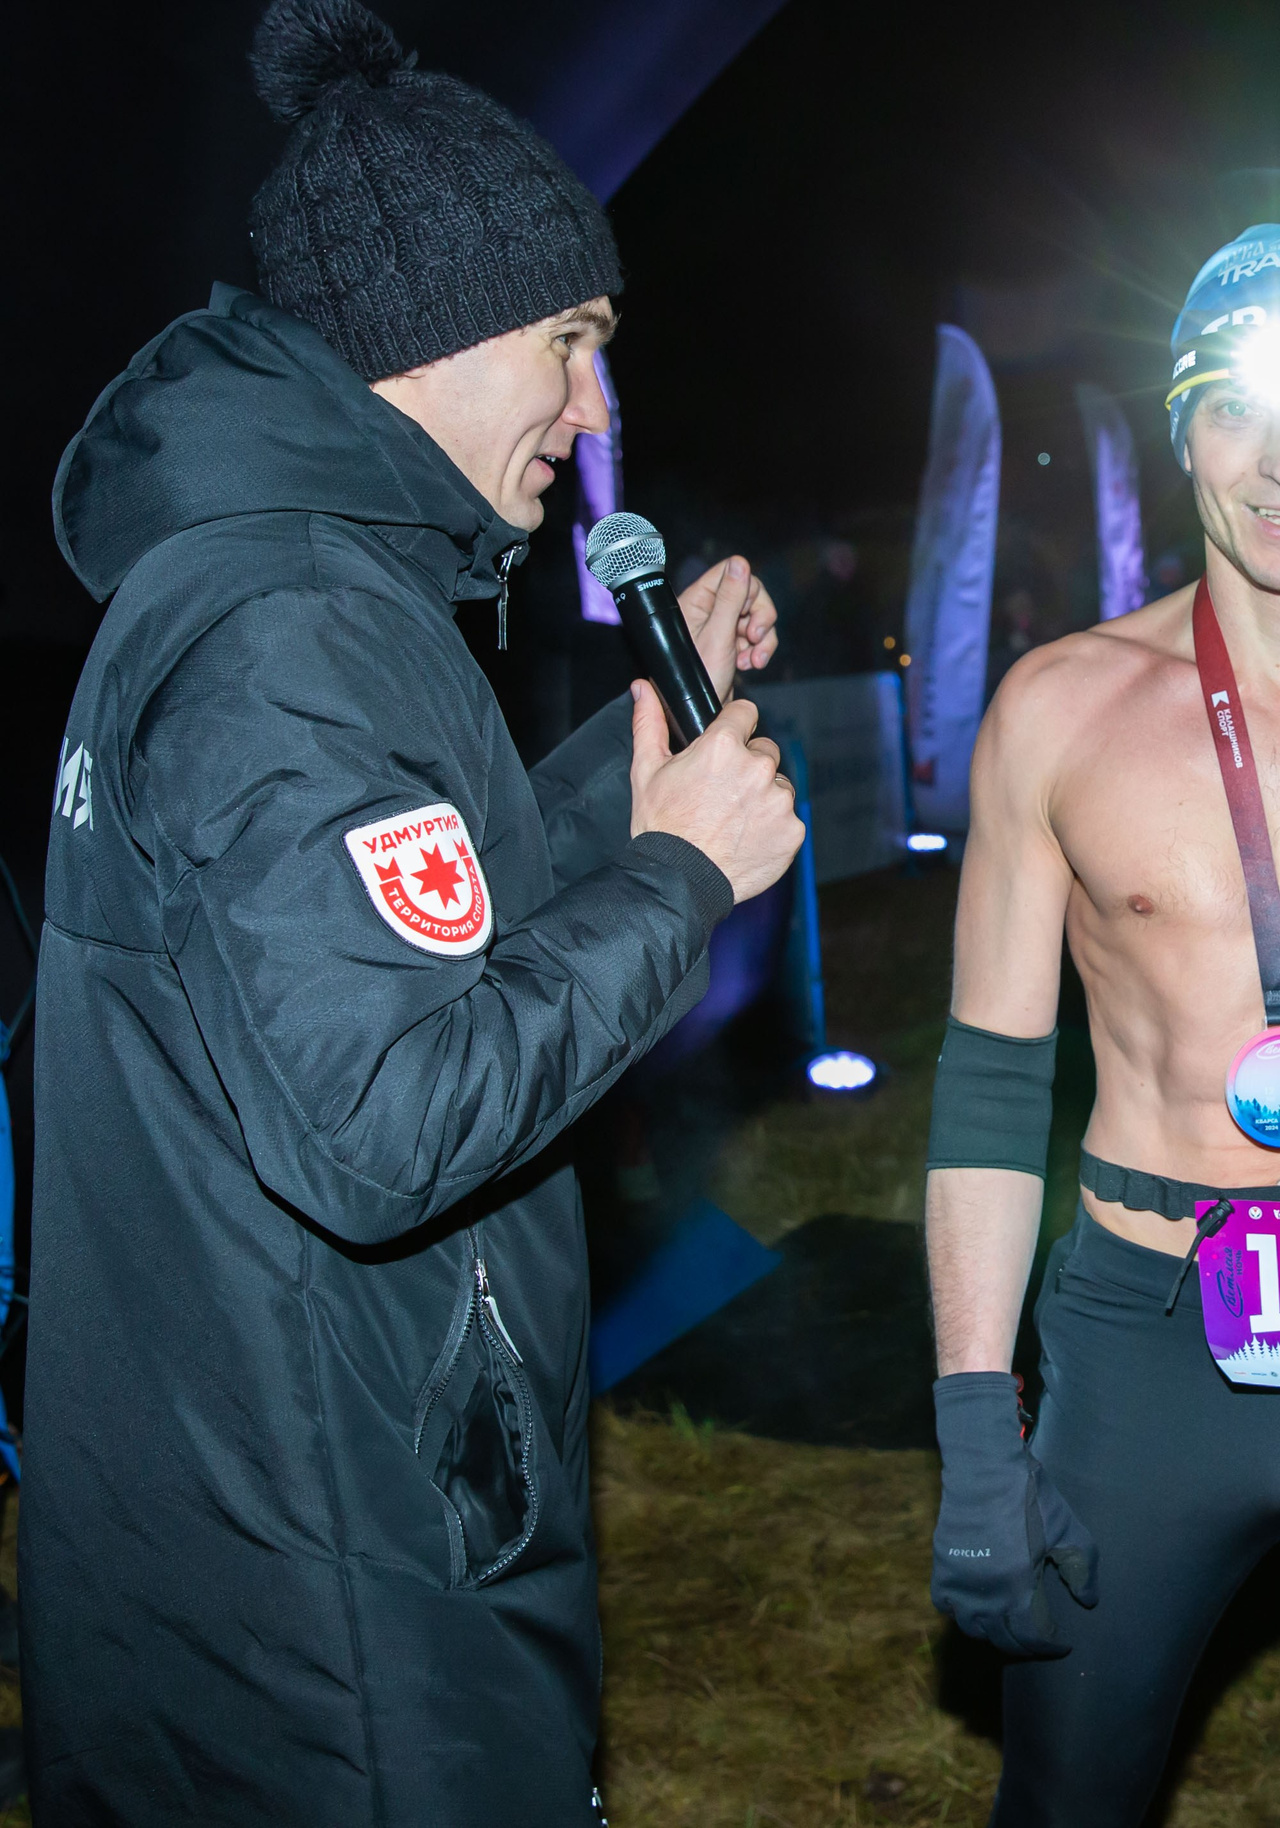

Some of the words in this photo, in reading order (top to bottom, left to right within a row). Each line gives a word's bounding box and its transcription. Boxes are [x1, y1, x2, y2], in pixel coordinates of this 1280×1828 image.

[637, 578, 664, 592] SHURE
[1216, 710, 1229, 736] СПОРТ
[1223, 708, 1243, 769] КАЛАШНИКОВ
[362, 814, 460, 854] УДМУРТИЯ
[388, 887, 475, 938] ТЕРРИТОРИЯ
[469, 864, 482, 923] СПОРТА
